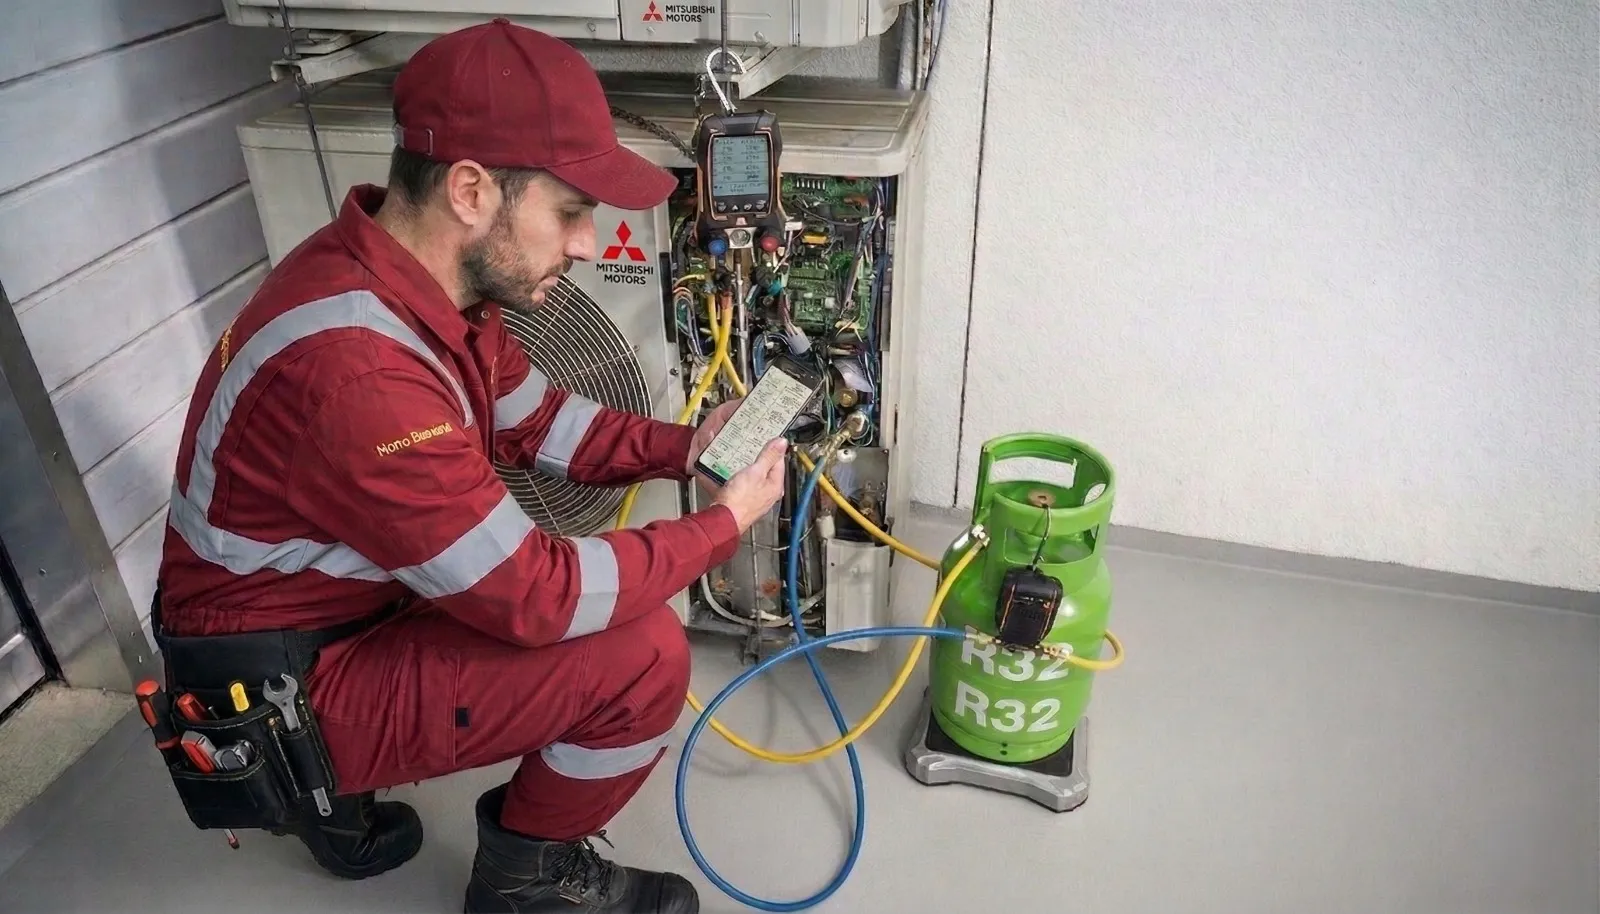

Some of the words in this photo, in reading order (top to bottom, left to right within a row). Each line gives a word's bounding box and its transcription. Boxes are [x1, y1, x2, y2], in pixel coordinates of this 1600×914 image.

[665, 5, 716, 14] MITSUBISHI
[666, 14, 702, 23] MOTORS
[596, 263, 654, 275] MITSUBISHI
[604, 274, 646, 285] MOTORS
[955, 680, 1061, 733] R32
